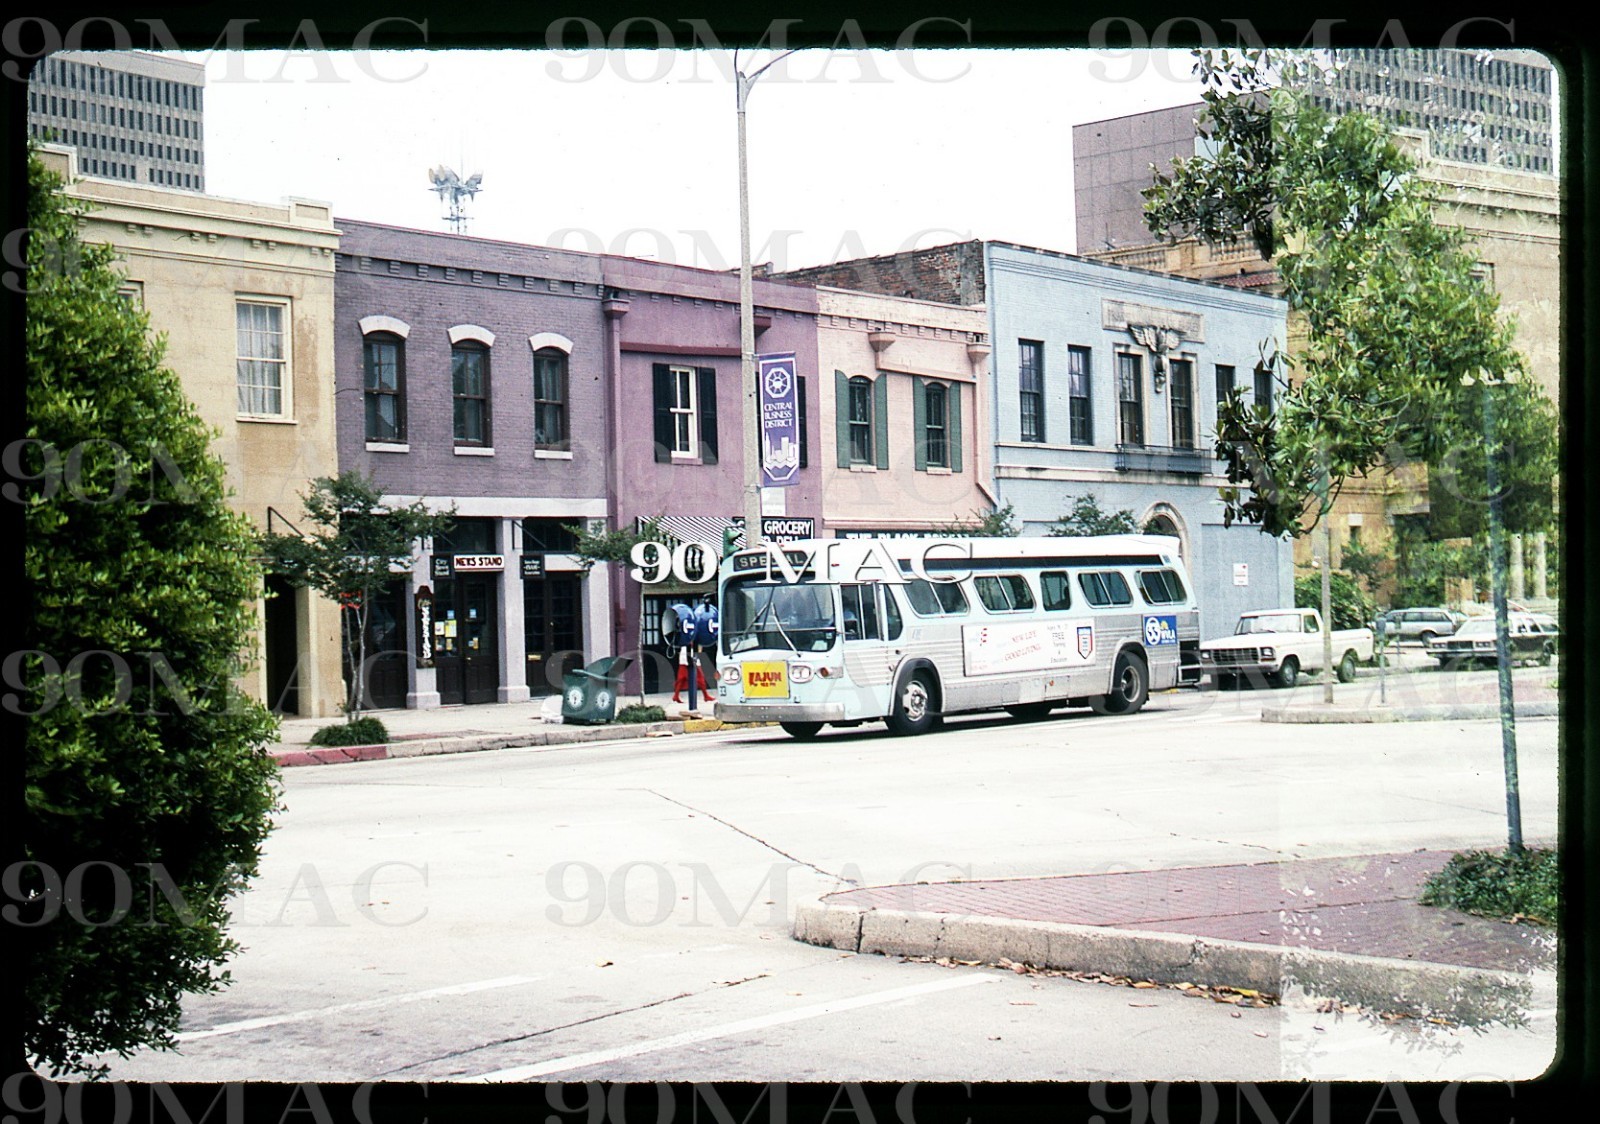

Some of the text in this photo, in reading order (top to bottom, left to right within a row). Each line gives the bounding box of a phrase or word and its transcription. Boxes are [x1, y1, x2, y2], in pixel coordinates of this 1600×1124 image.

[764, 402, 794, 412] CENTRAL
[765, 411, 792, 420] BUSINESS
[765, 419, 793, 428] DISTRICT
[764, 520, 811, 535] GROCERY
[478, 556, 503, 567] STAND
